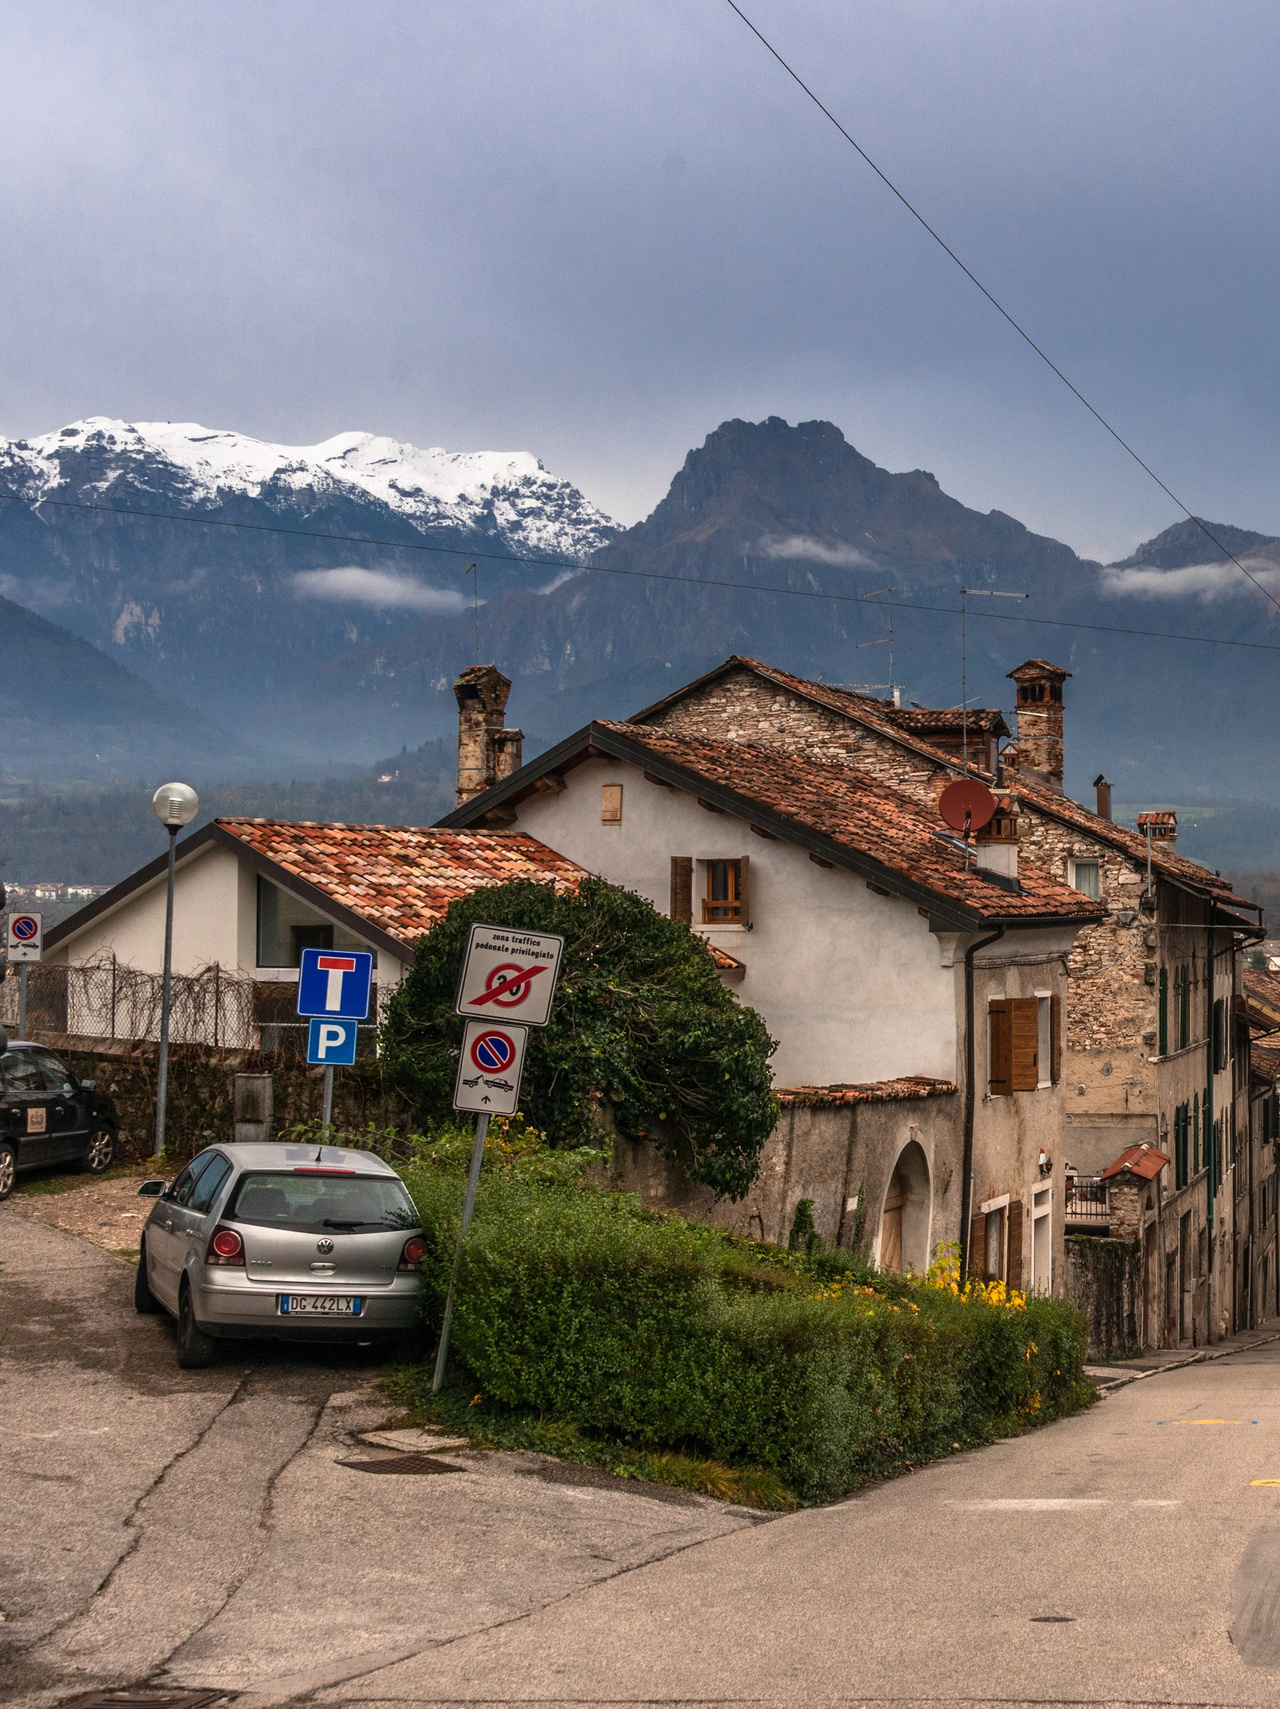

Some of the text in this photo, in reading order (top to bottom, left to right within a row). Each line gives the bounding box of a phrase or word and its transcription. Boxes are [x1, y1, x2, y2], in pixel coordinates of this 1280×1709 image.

[492, 934, 541, 947] zona traffico
[475, 941, 554, 959] pedonale privilegiato
[318, 1024, 346, 1059] P
[312, 1297, 353, 1311] 442LX
